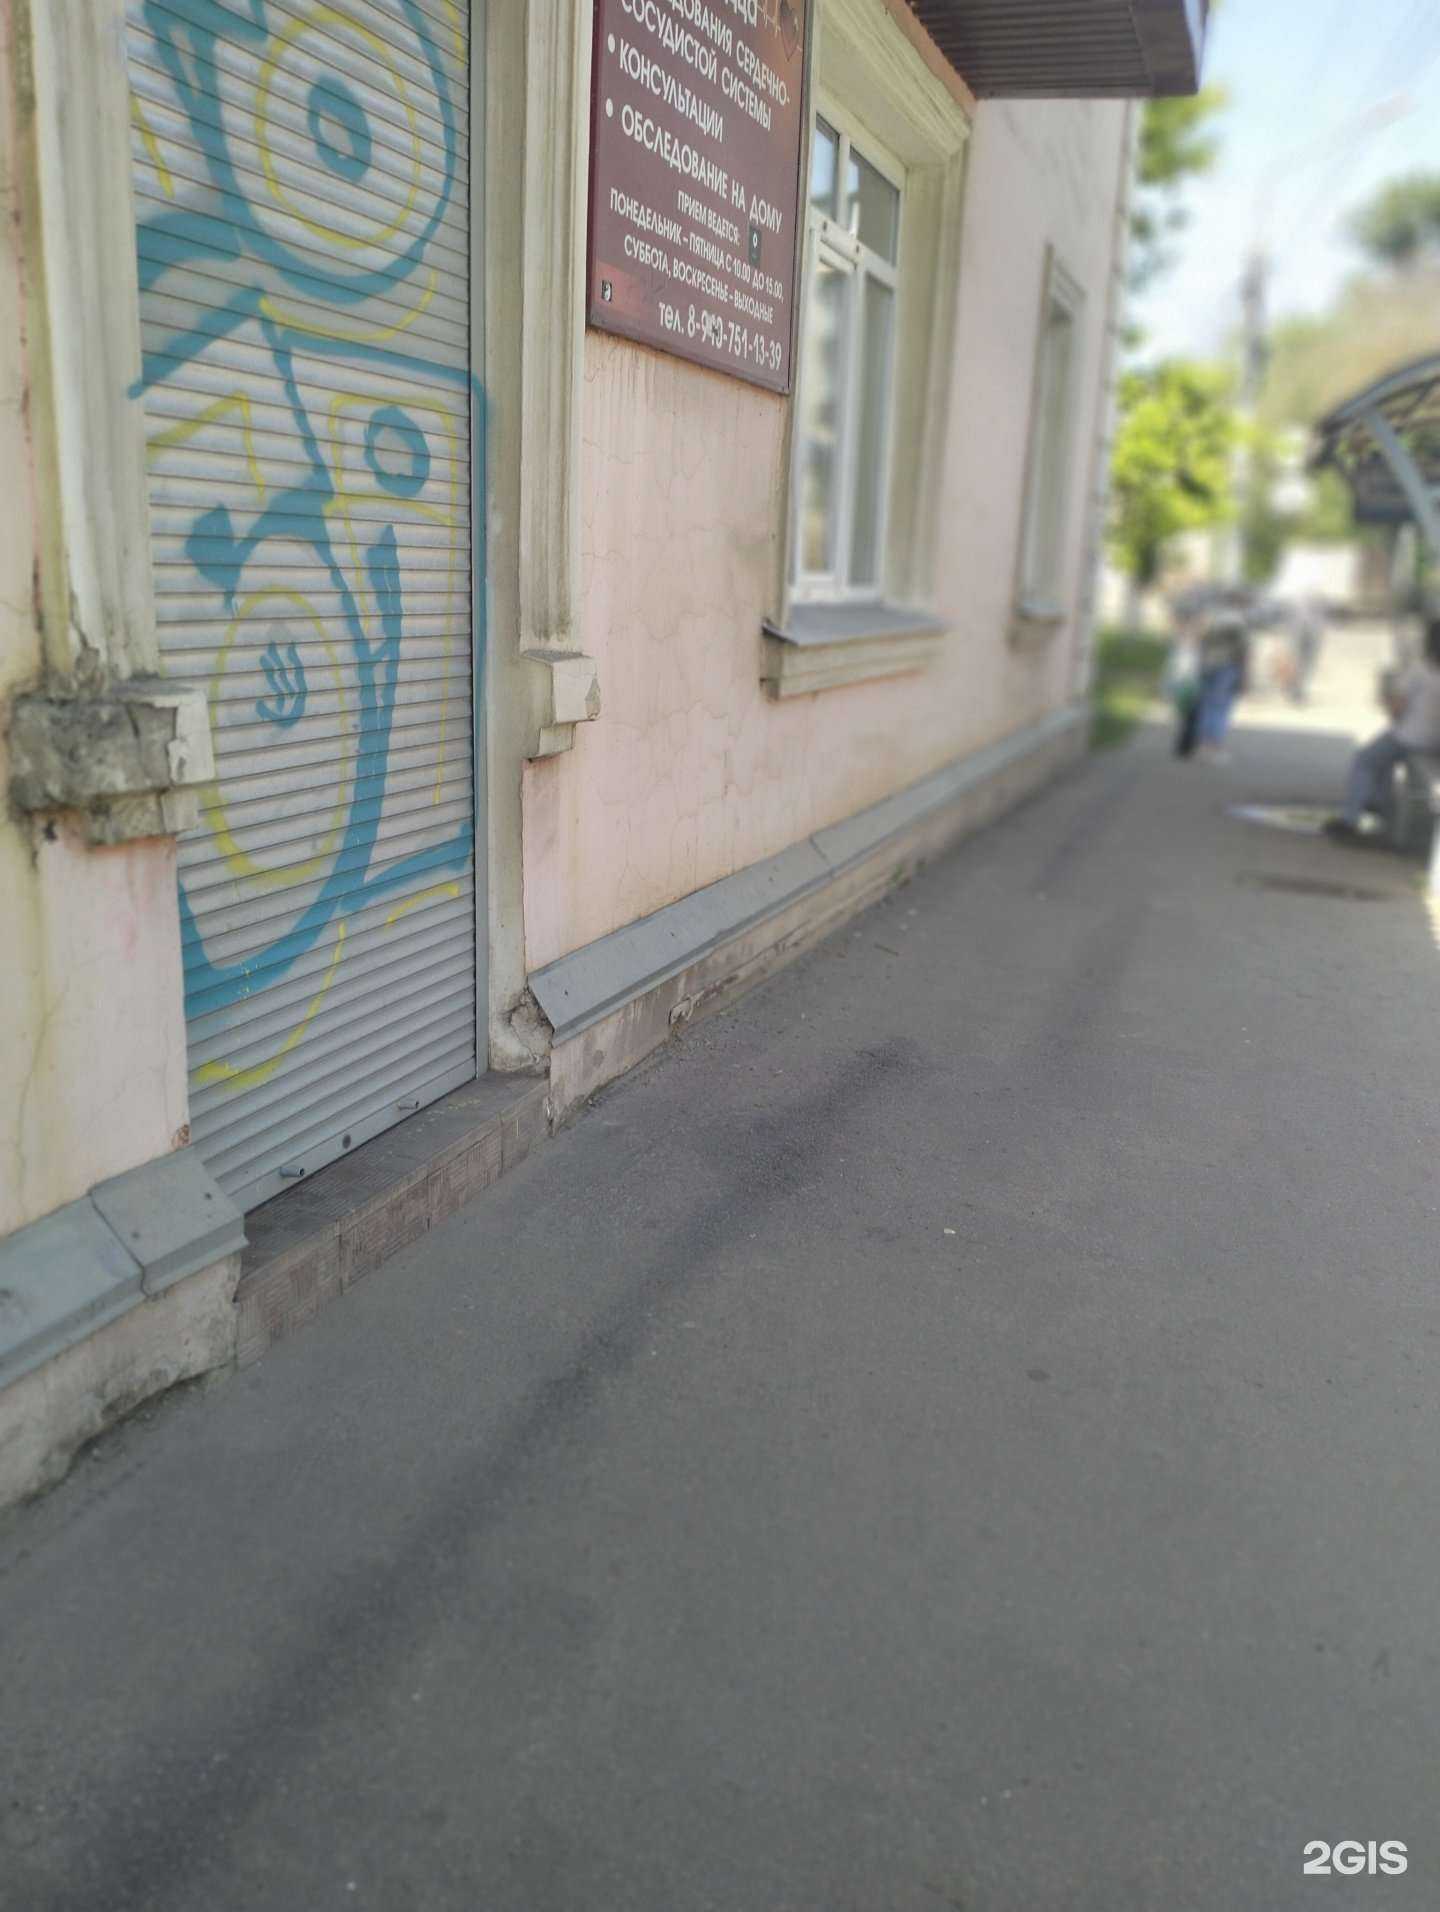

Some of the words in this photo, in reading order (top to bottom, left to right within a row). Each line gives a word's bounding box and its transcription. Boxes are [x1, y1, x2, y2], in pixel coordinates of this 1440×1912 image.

[620, 38, 724, 143] КОНСУЛЬТАЦИИ
[721, 67, 772, 131] СИСТЕМЫ
[621, 104, 728, 200] ОБСЛЕДОВАНИЕ
[732, 179, 746, 212] НА
[749, 195, 783, 234] ДОМУ
[678, 190, 707, 226] ПРИЕМ
[610, 188, 682, 245] ПОНЕДЕЛЬНИК
[689, 233, 725, 270] ПЯТНИЦА
[726, 254, 732, 271] С
[732, 258, 751, 283] 10.00
[752, 270, 765, 291] ДО
[624, 235, 671, 279] СУББОТА,
[673, 259, 729, 302] ВОСКРЕСЕНЬЕ
[734, 291, 774, 324] ВЫХОДНЫЕ
[658, 302, 684, 334] тел.
